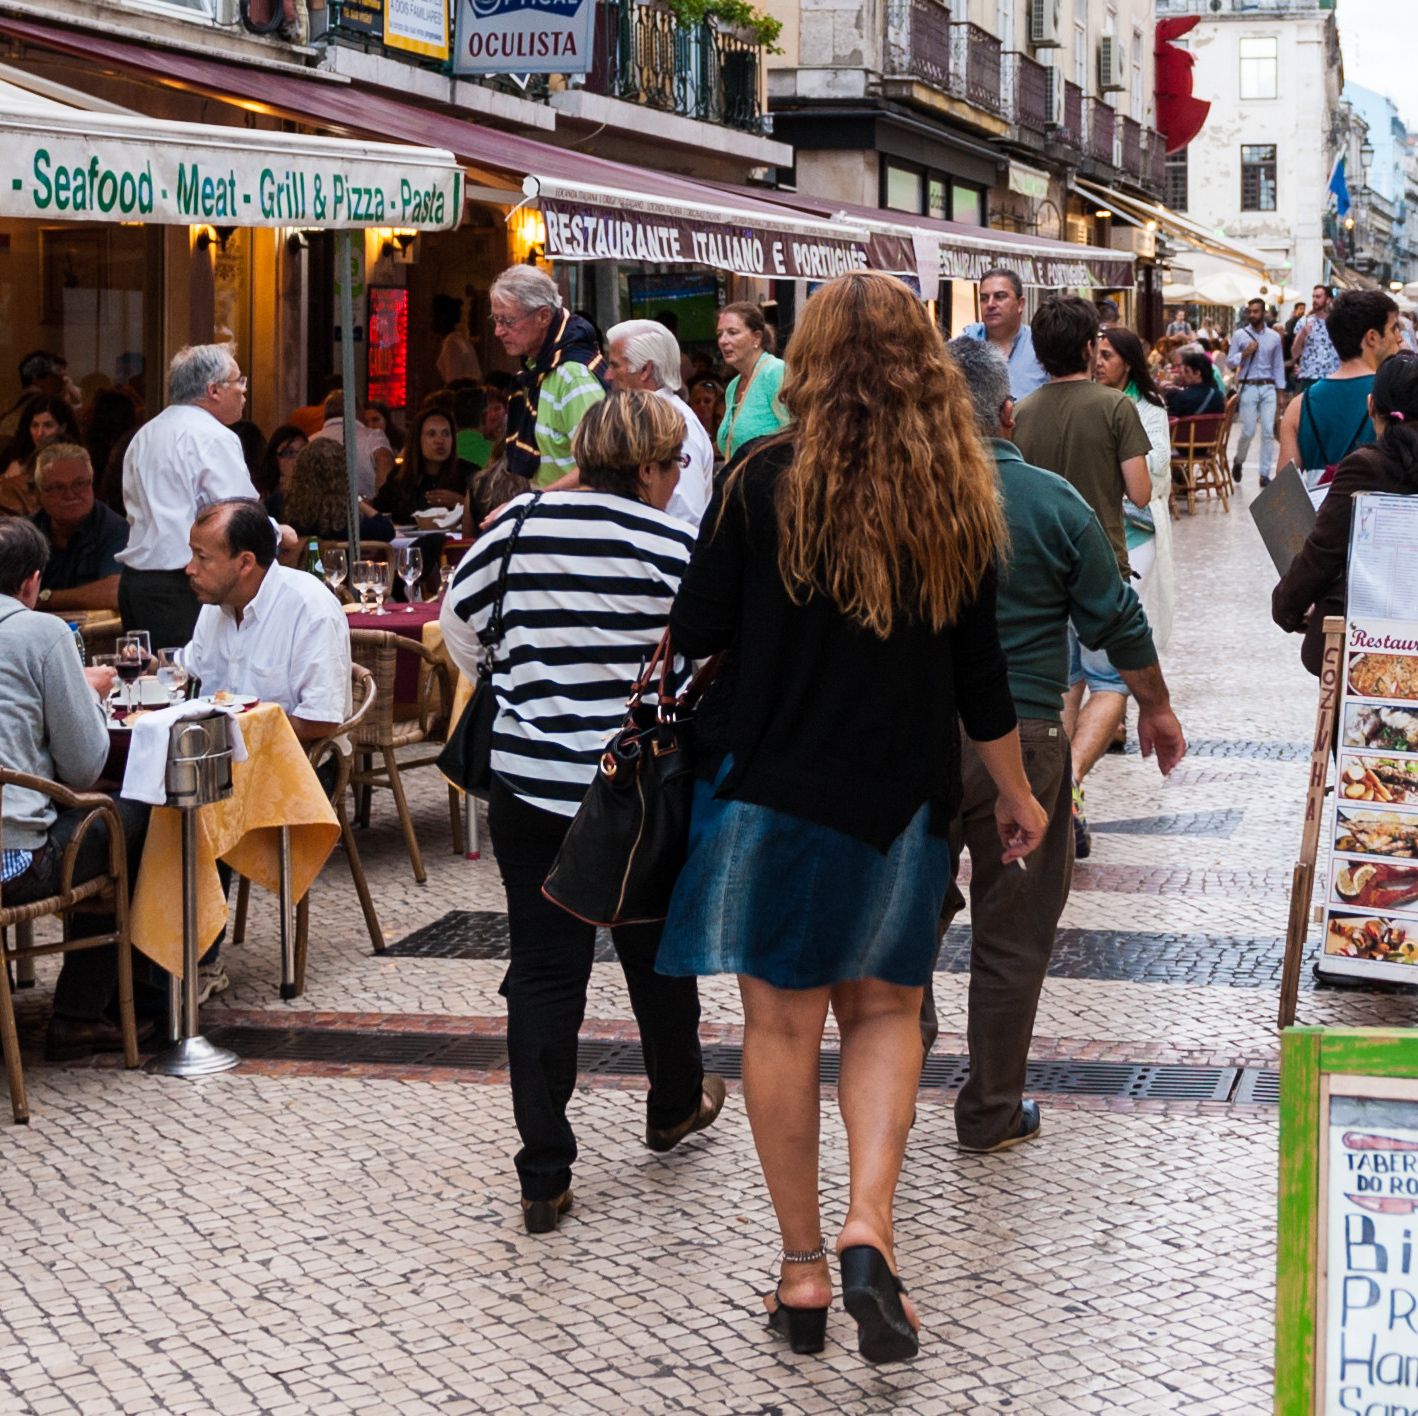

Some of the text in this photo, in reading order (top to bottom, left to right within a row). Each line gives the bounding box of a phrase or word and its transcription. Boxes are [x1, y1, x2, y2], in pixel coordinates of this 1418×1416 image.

[468, 31, 578, 59] OCULISTA
[33, 148, 154, 215] Seafood
[177, 164, 236, 218] Meat
[259, 168, 307, 224] Grill
[313, 176, 328, 221] &
[333, 178, 385, 224] Pizza
[400, 178, 444, 224] Pasta
[546, 210, 868, 278] RESTAURANTE ITALIANO E PORTUGUÊS
[939, 248, 992, 279] ESTAURANTE
[1306, 647, 1338, 820] COZINHA
[1356, 1174, 1382, 1193] DO
